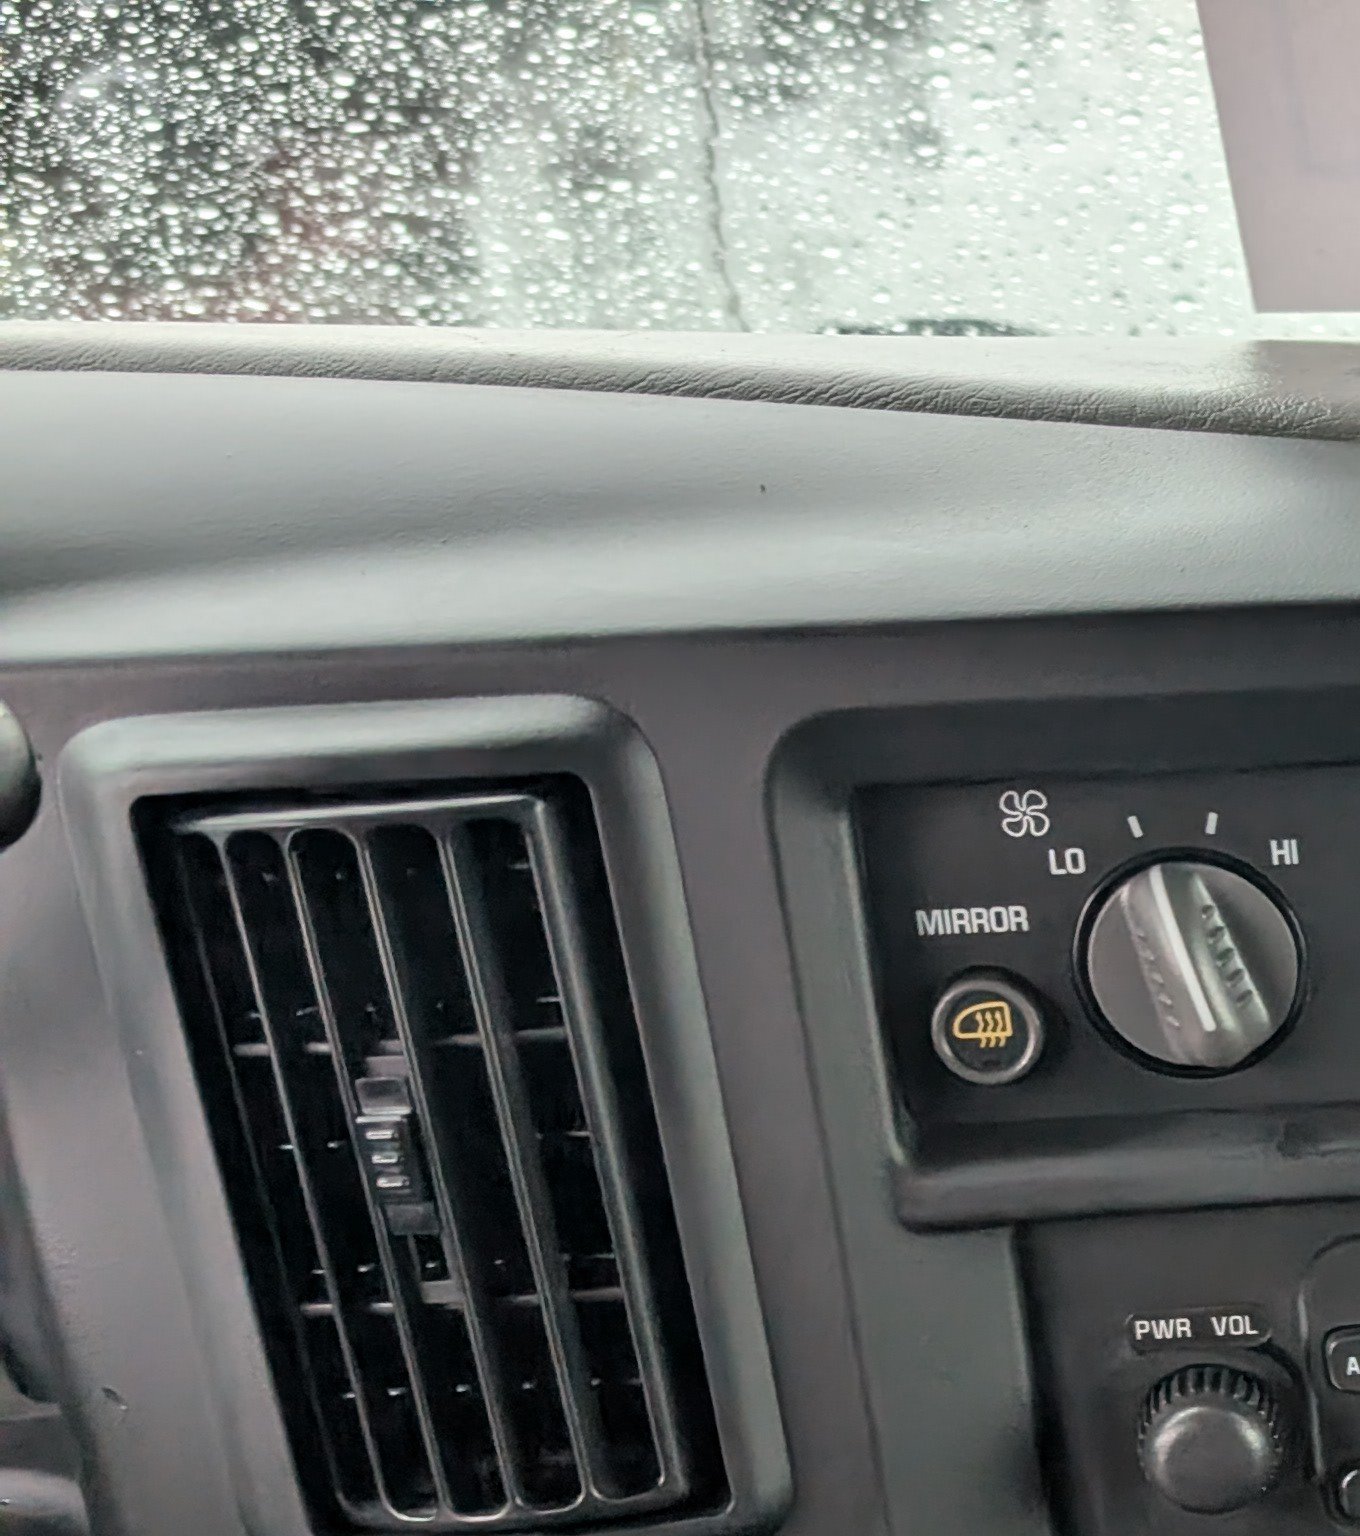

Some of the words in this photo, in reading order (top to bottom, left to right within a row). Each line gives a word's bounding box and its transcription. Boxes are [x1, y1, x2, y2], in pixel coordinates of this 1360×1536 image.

[1048, 848, 1085, 875] LO
[1270, 839, 1299, 866] HI
[915, 905, 1029, 936] MIRROR
[1134, 1317, 1192, 1341] PWR
[1210, 1314, 1258, 1338] VOL
